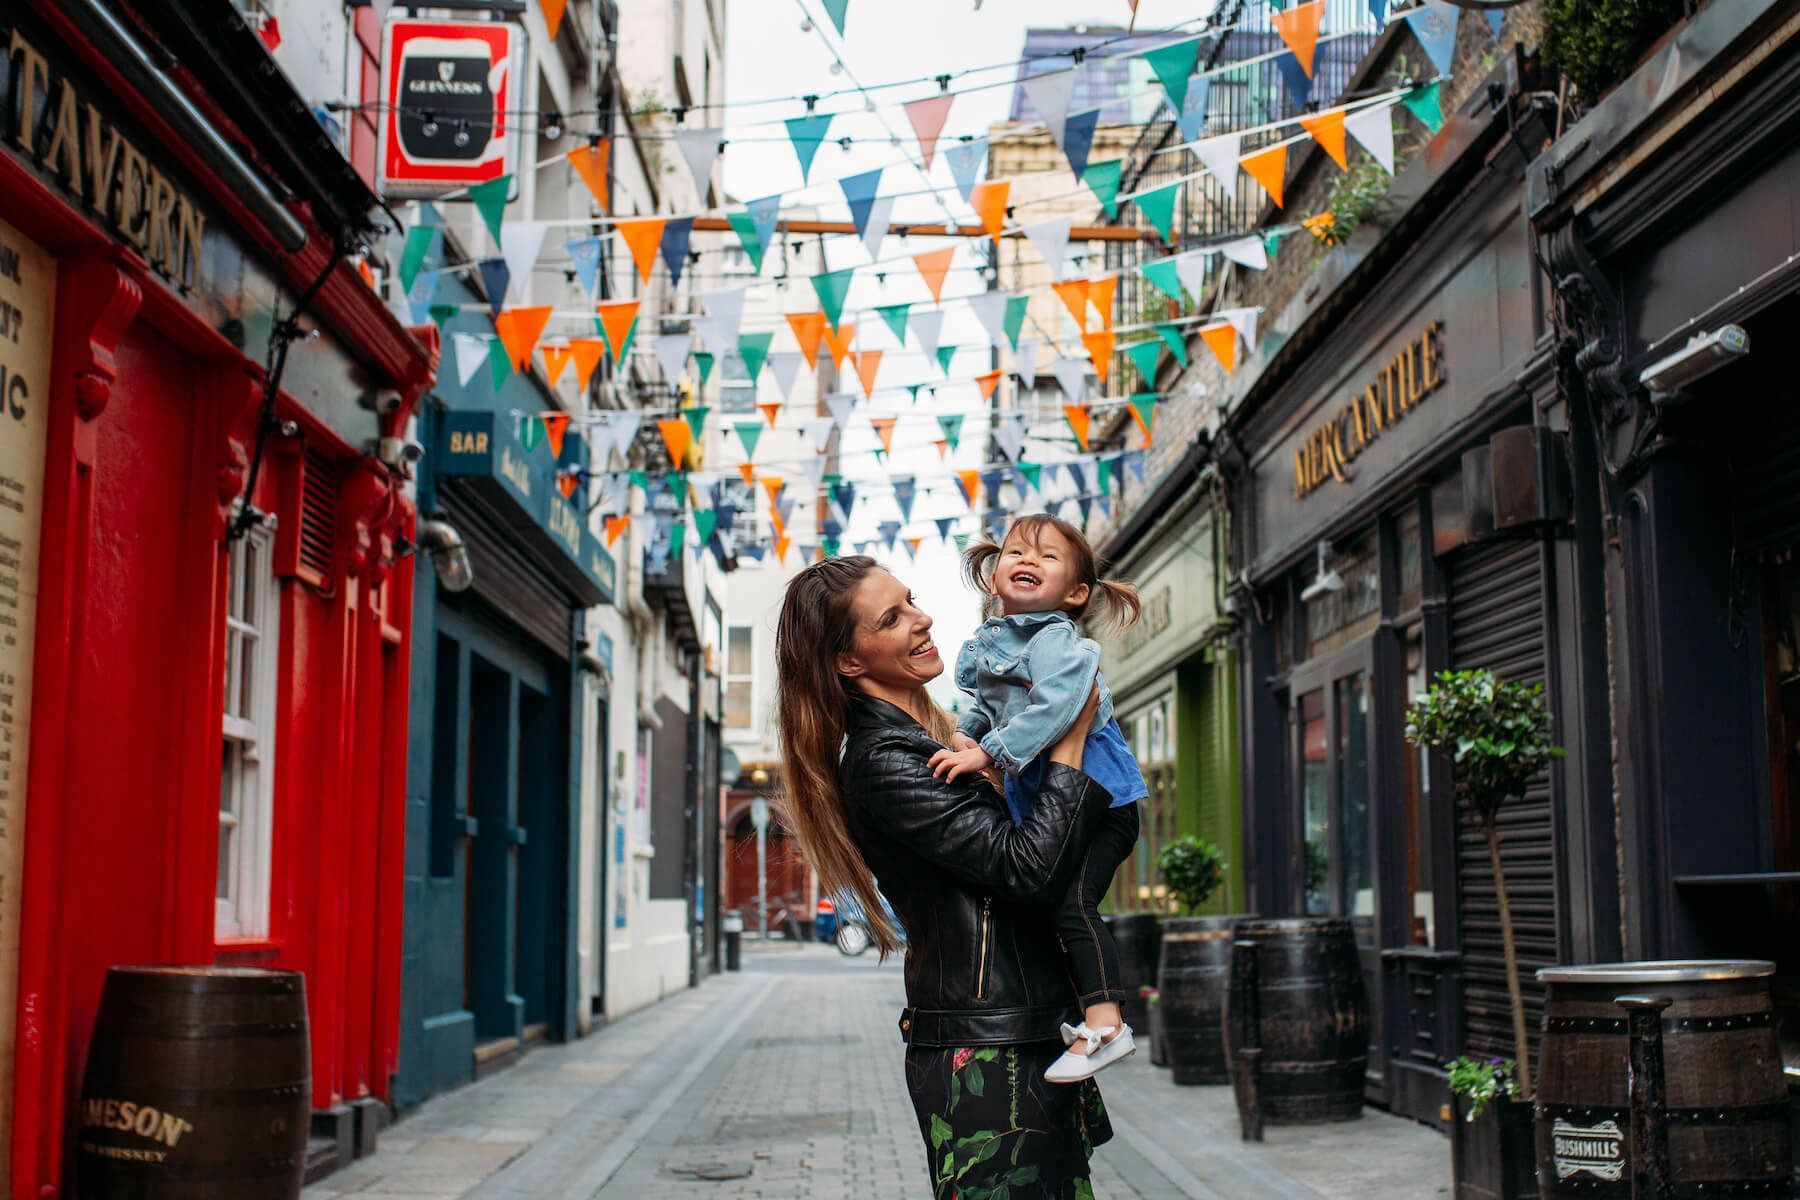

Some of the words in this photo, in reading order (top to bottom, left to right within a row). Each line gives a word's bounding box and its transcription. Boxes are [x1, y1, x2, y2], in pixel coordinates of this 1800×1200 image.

[409, 79, 483, 94] GUINNESS
[9, 27, 205, 296] TAVERN
[1293, 320, 1440, 501] MERCANTILE
[450, 431, 488, 454] BAR
[1554, 1136, 1620, 1158] BUSHMILLS
